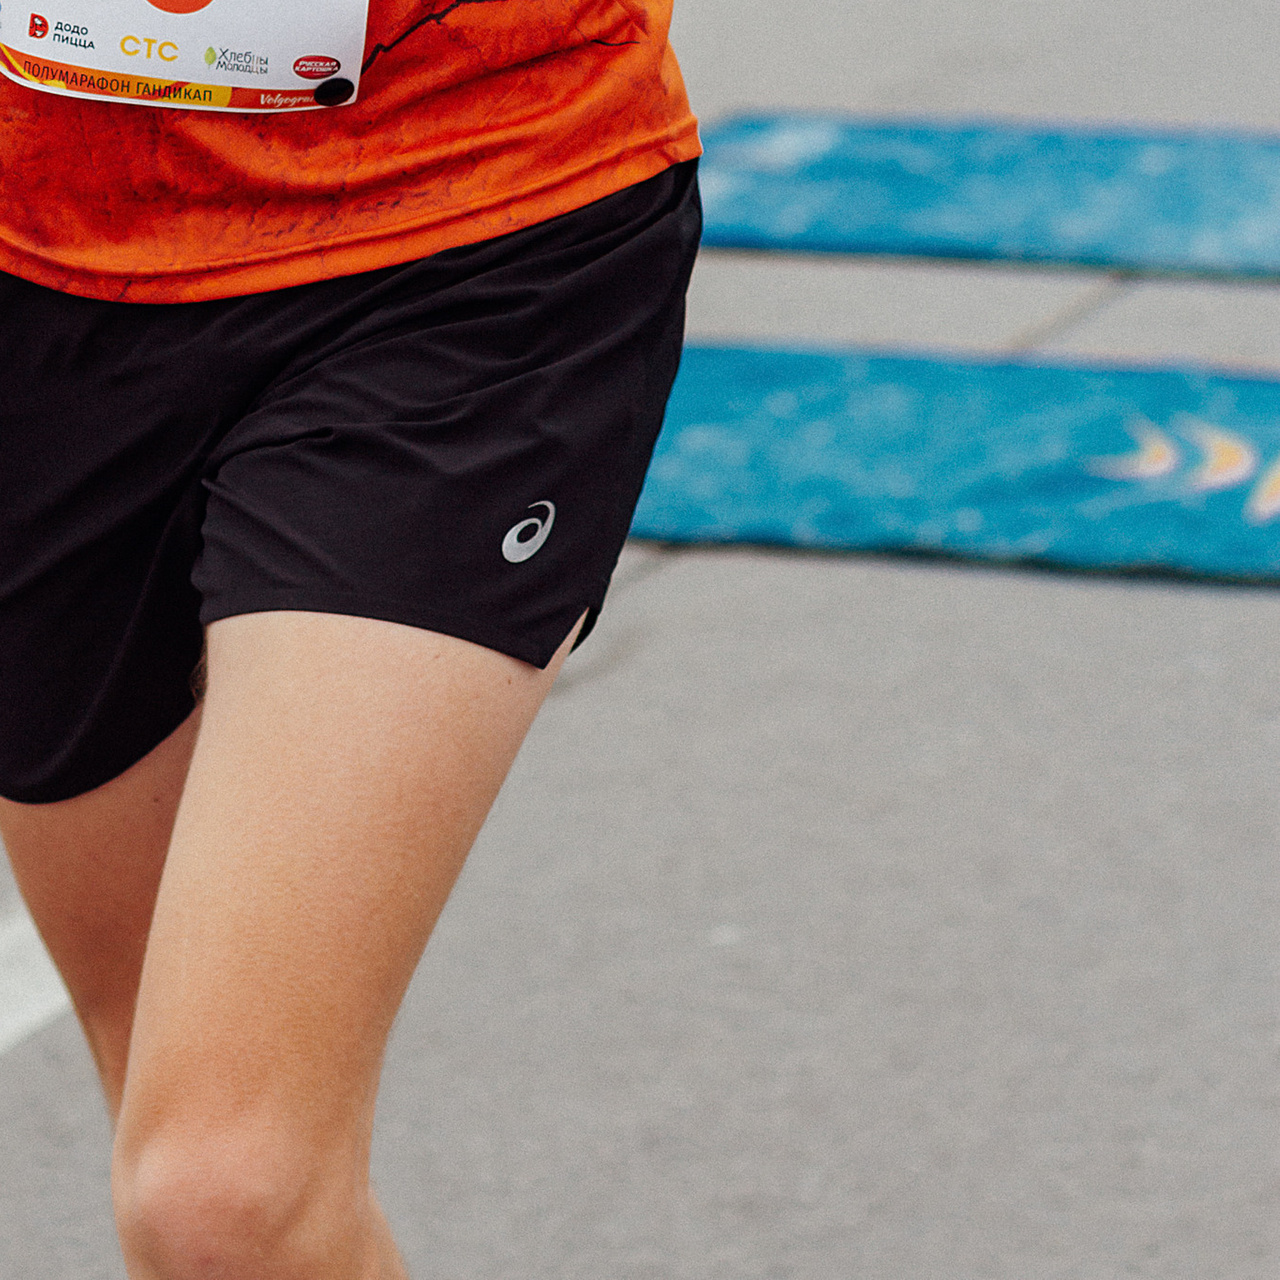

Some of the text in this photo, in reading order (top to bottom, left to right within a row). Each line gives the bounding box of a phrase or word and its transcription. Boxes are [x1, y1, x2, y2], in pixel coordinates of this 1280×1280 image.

[53, 21, 90, 37] ДОДО
[52, 32, 96, 50] ПИЦЦА
[22, 60, 213, 102] ПОЛУМАРАФОН ГАНДИКАП
[260, 92, 315, 108] Volgogra
